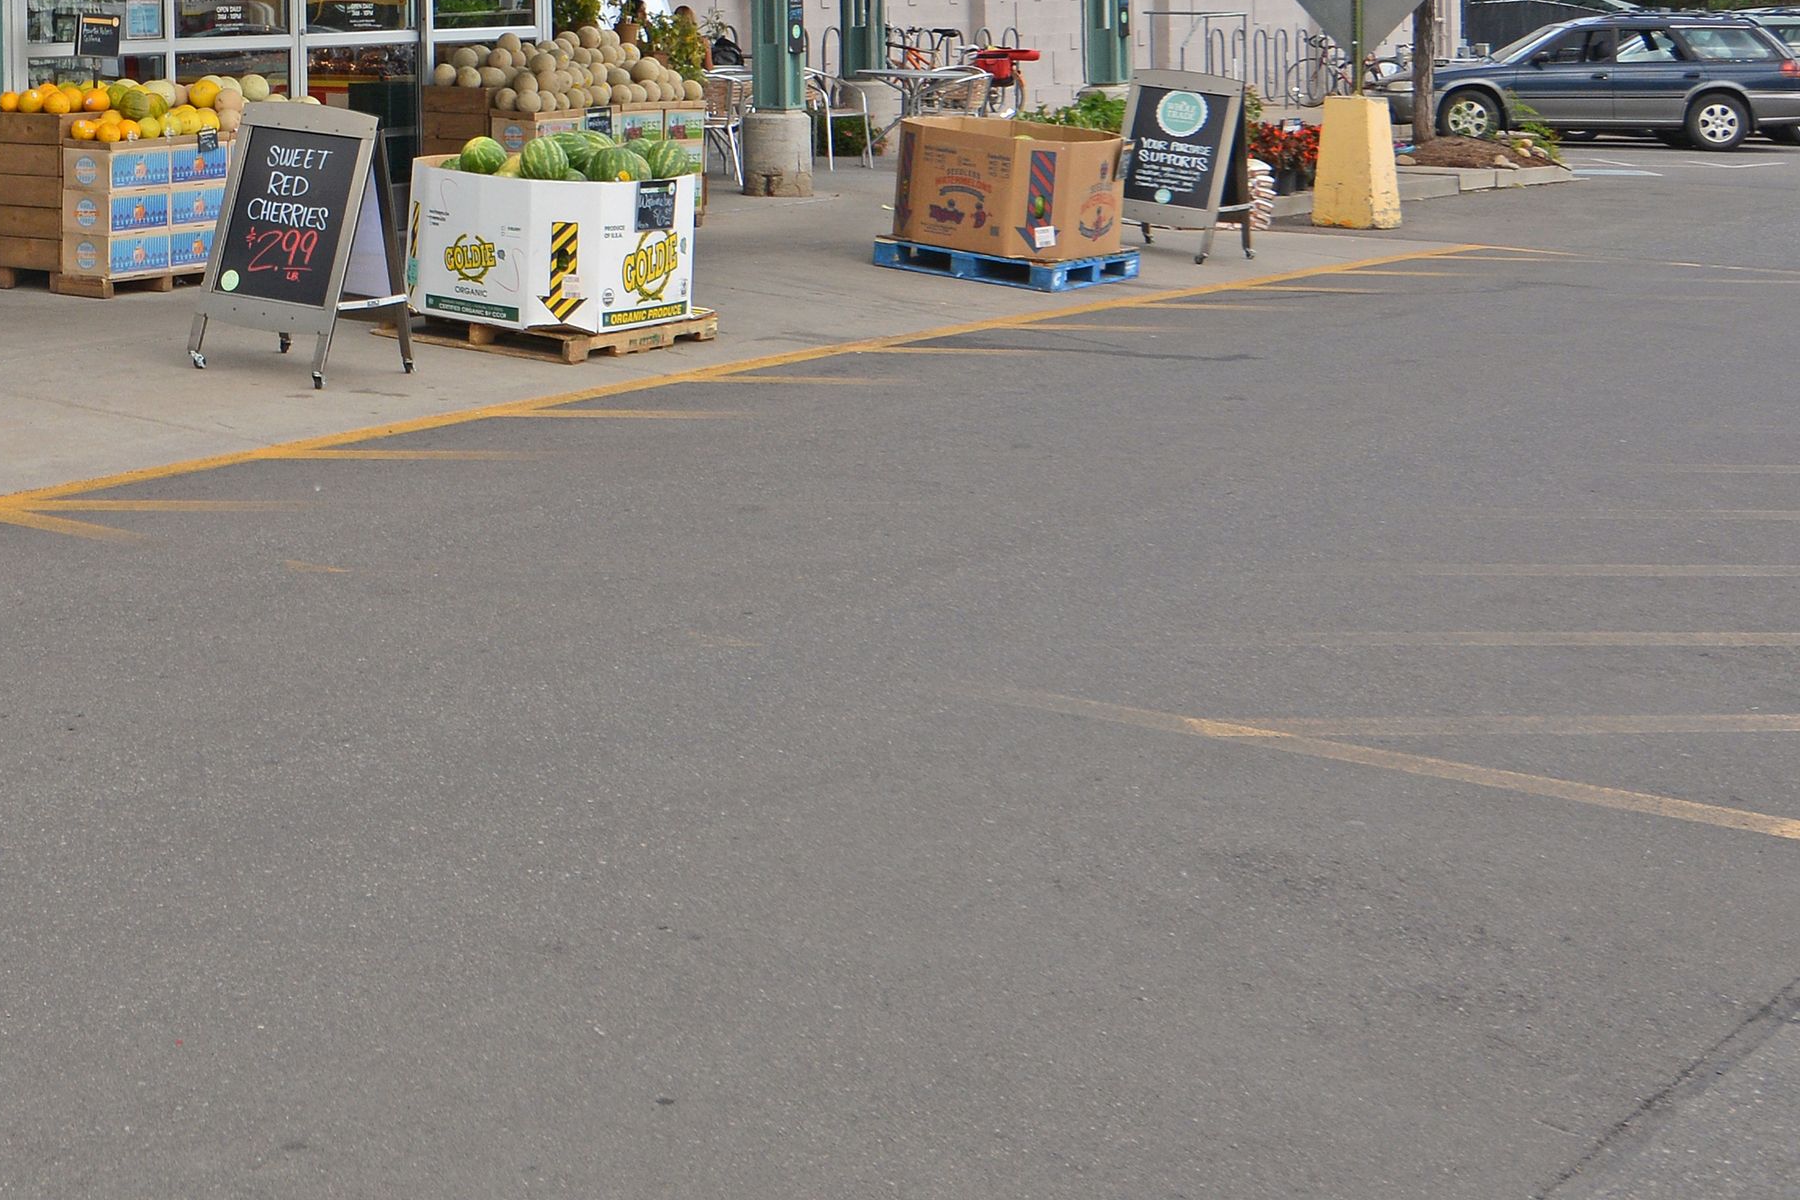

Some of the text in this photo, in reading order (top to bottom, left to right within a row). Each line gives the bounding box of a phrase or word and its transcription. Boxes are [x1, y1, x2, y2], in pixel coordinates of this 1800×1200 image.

[267, 145, 333, 170] SWEET
[688, 152, 702, 162] EST
[1138, 149, 1209, 172] SUPPORTS
[267, 171, 309, 196] RED
[248, 198, 329, 231] CHERRIES
[245, 226, 319, 272] $2.99
[445, 242, 497, 272] GOLDIE
[622, 232, 678, 294] GOLDIE
[455, 285, 488, 298] ORGANIC
[461, 306, 484, 316] ORGANIC
[610, 304, 682, 325] ORGANIC PRODUCE
